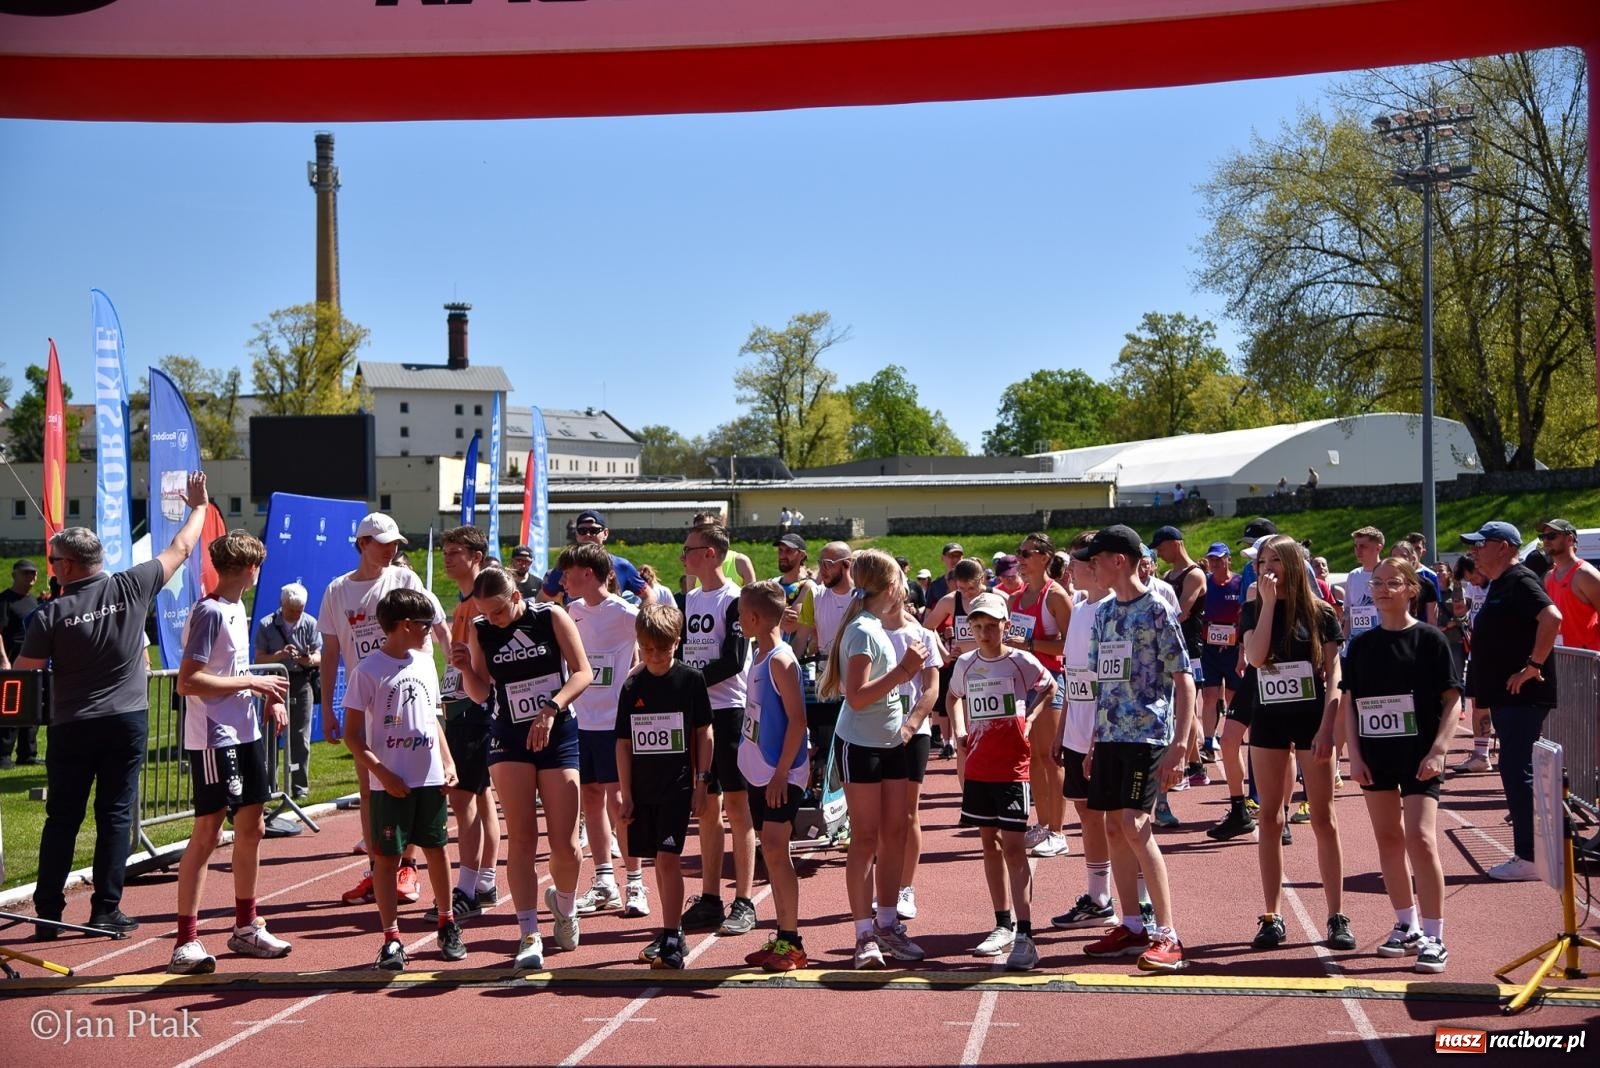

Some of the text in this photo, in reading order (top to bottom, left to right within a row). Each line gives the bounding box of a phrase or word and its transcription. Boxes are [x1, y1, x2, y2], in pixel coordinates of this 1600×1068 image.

[64, 601, 126, 628] RACIBÓRZ
[1474, 602, 1483, 611] 03
[688, 613, 715, 634] GO
[1354, 616, 1370, 626] 033
[1009, 624, 1027, 638] 058
[1210, 632, 1229, 641] 094
[493, 645, 547, 664] adidas
[1102, 659, 1121, 675] 015
[1070, 681, 1089, 696] 014
[1265, 678, 1299, 696] 003
[2, 680, 21, 714] 0
[519, 694, 547, 714] 016
[973, 696, 999, 713] 010
[1369, 713, 1399, 730] 001
[386, 732, 434, 750] trophy
[637, 730, 669, 746] 008
